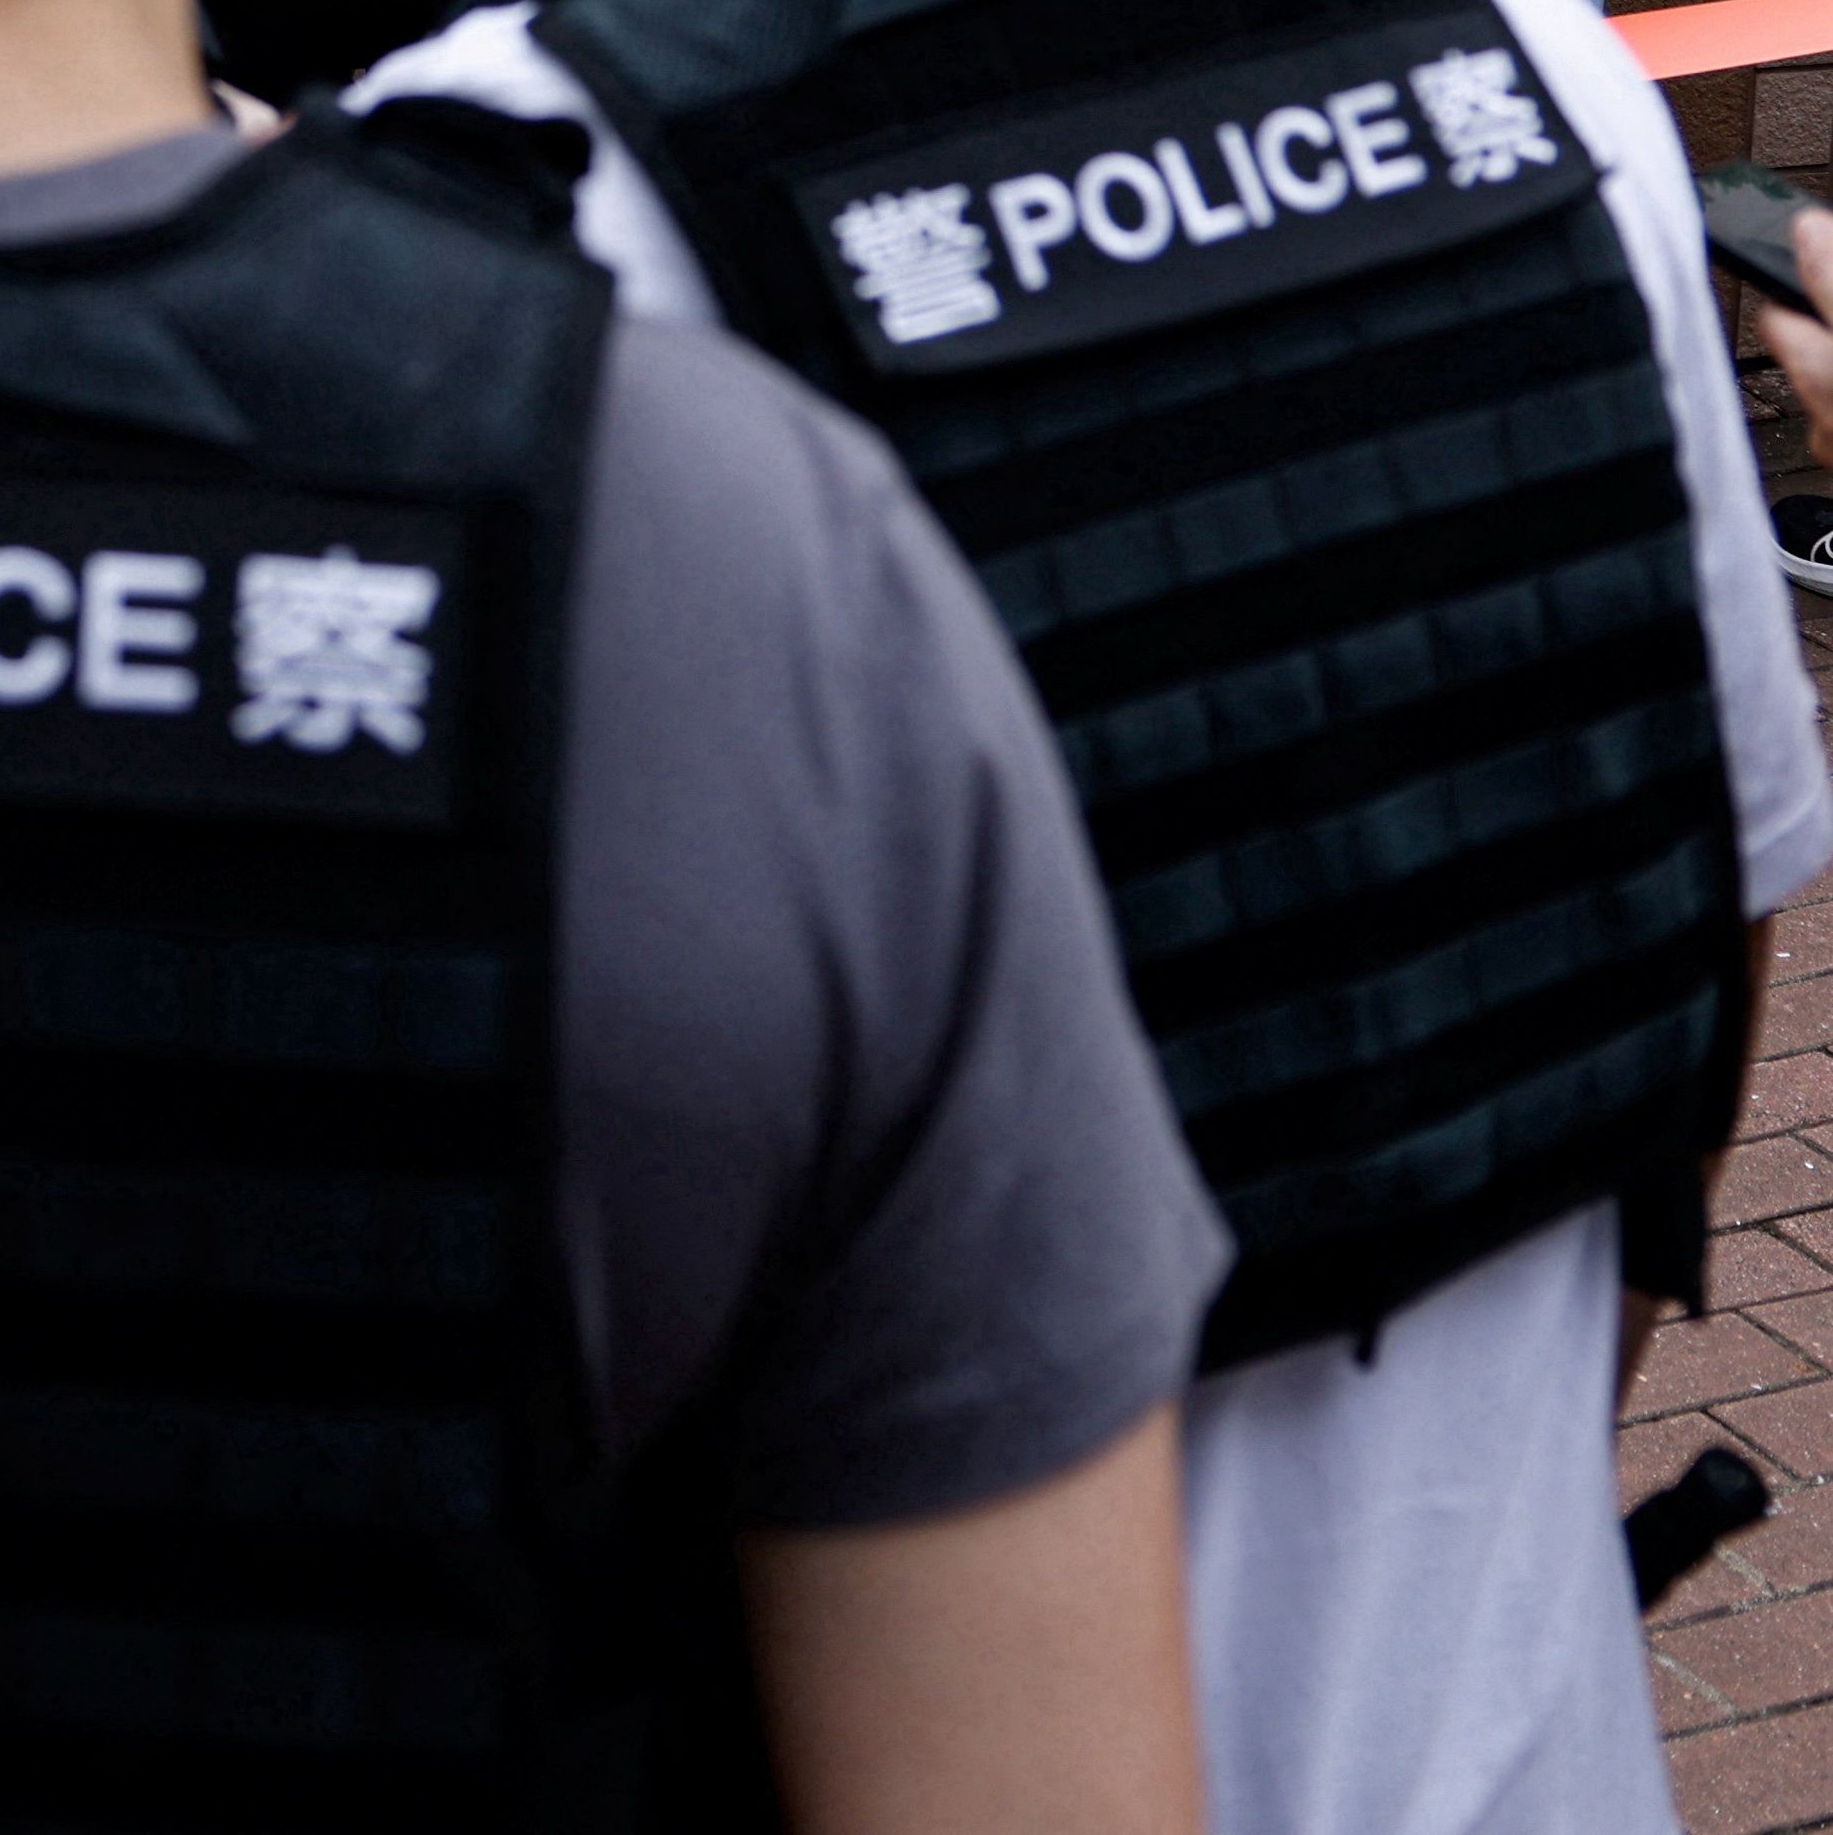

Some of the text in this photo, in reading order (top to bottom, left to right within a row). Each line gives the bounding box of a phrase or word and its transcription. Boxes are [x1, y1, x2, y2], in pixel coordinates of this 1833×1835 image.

[831, 47, 1559, 346] 警 POLICE 察
[235, 548, 439, 752] 察
